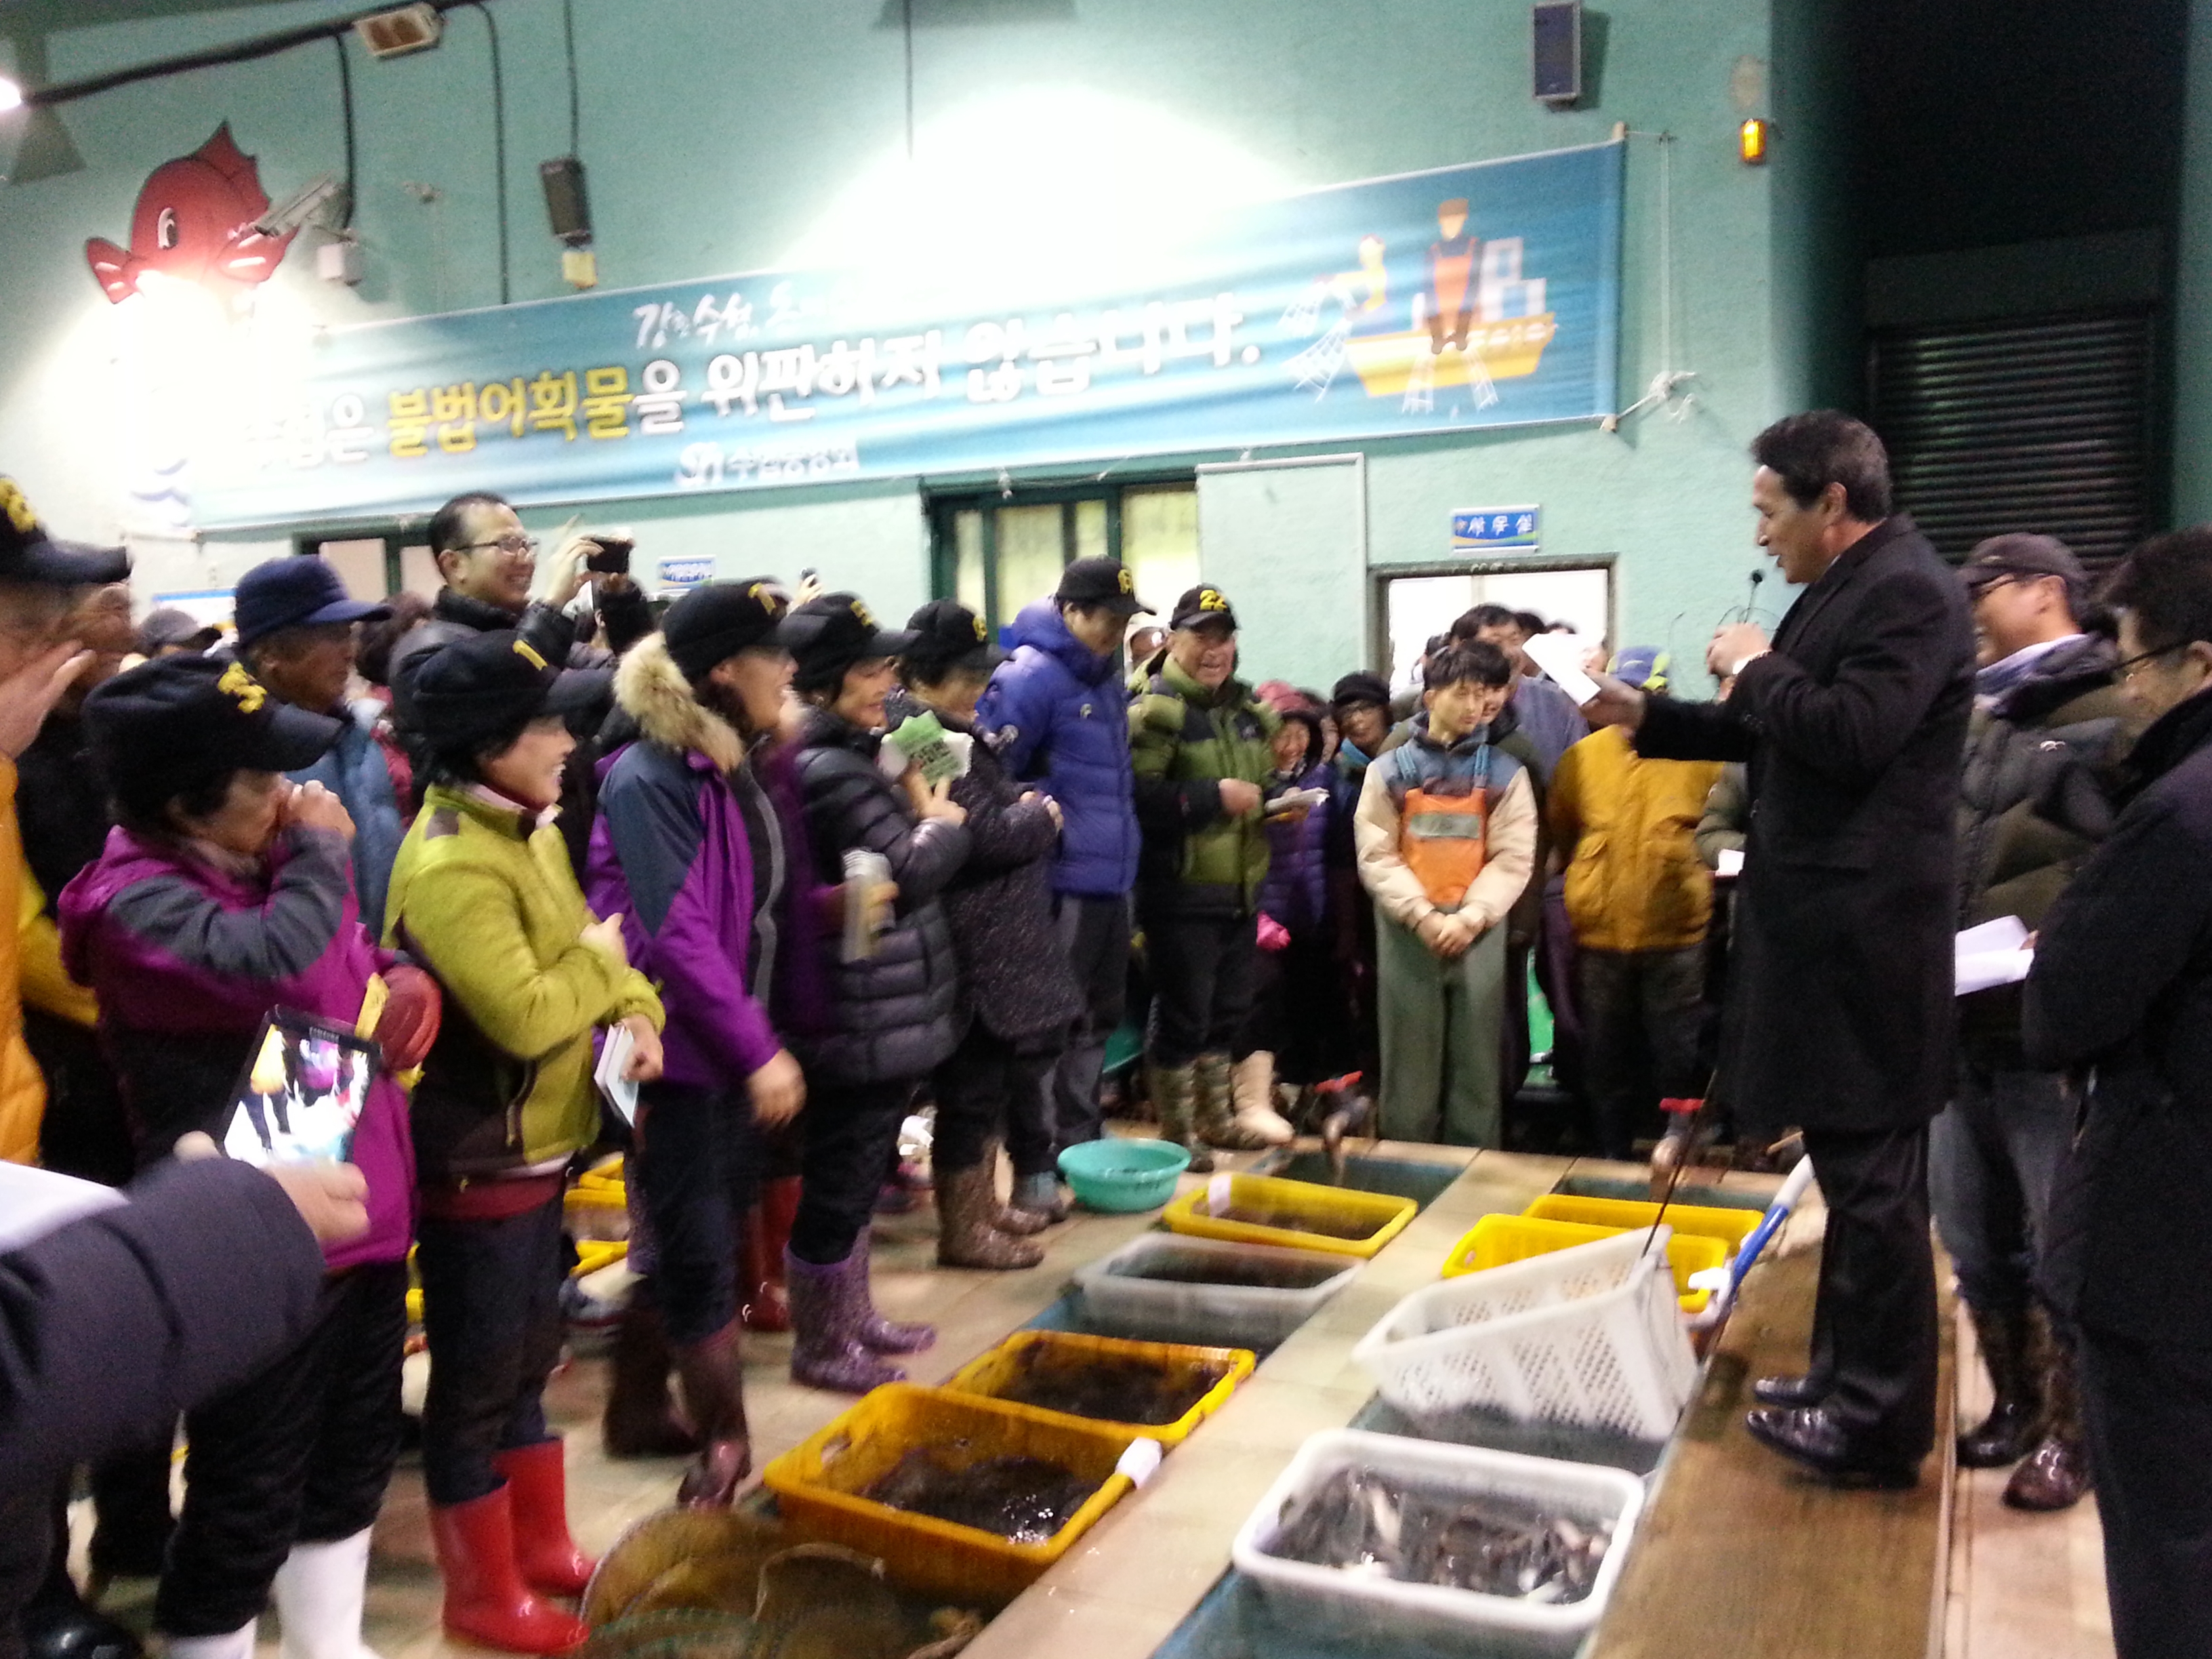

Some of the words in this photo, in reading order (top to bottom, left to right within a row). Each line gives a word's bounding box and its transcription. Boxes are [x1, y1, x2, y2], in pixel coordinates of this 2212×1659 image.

[386, 359, 688, 457] 불법어획물을
[700, 329, 943, 422] 위판하지
[1200, 589, 1227, 612] 22
